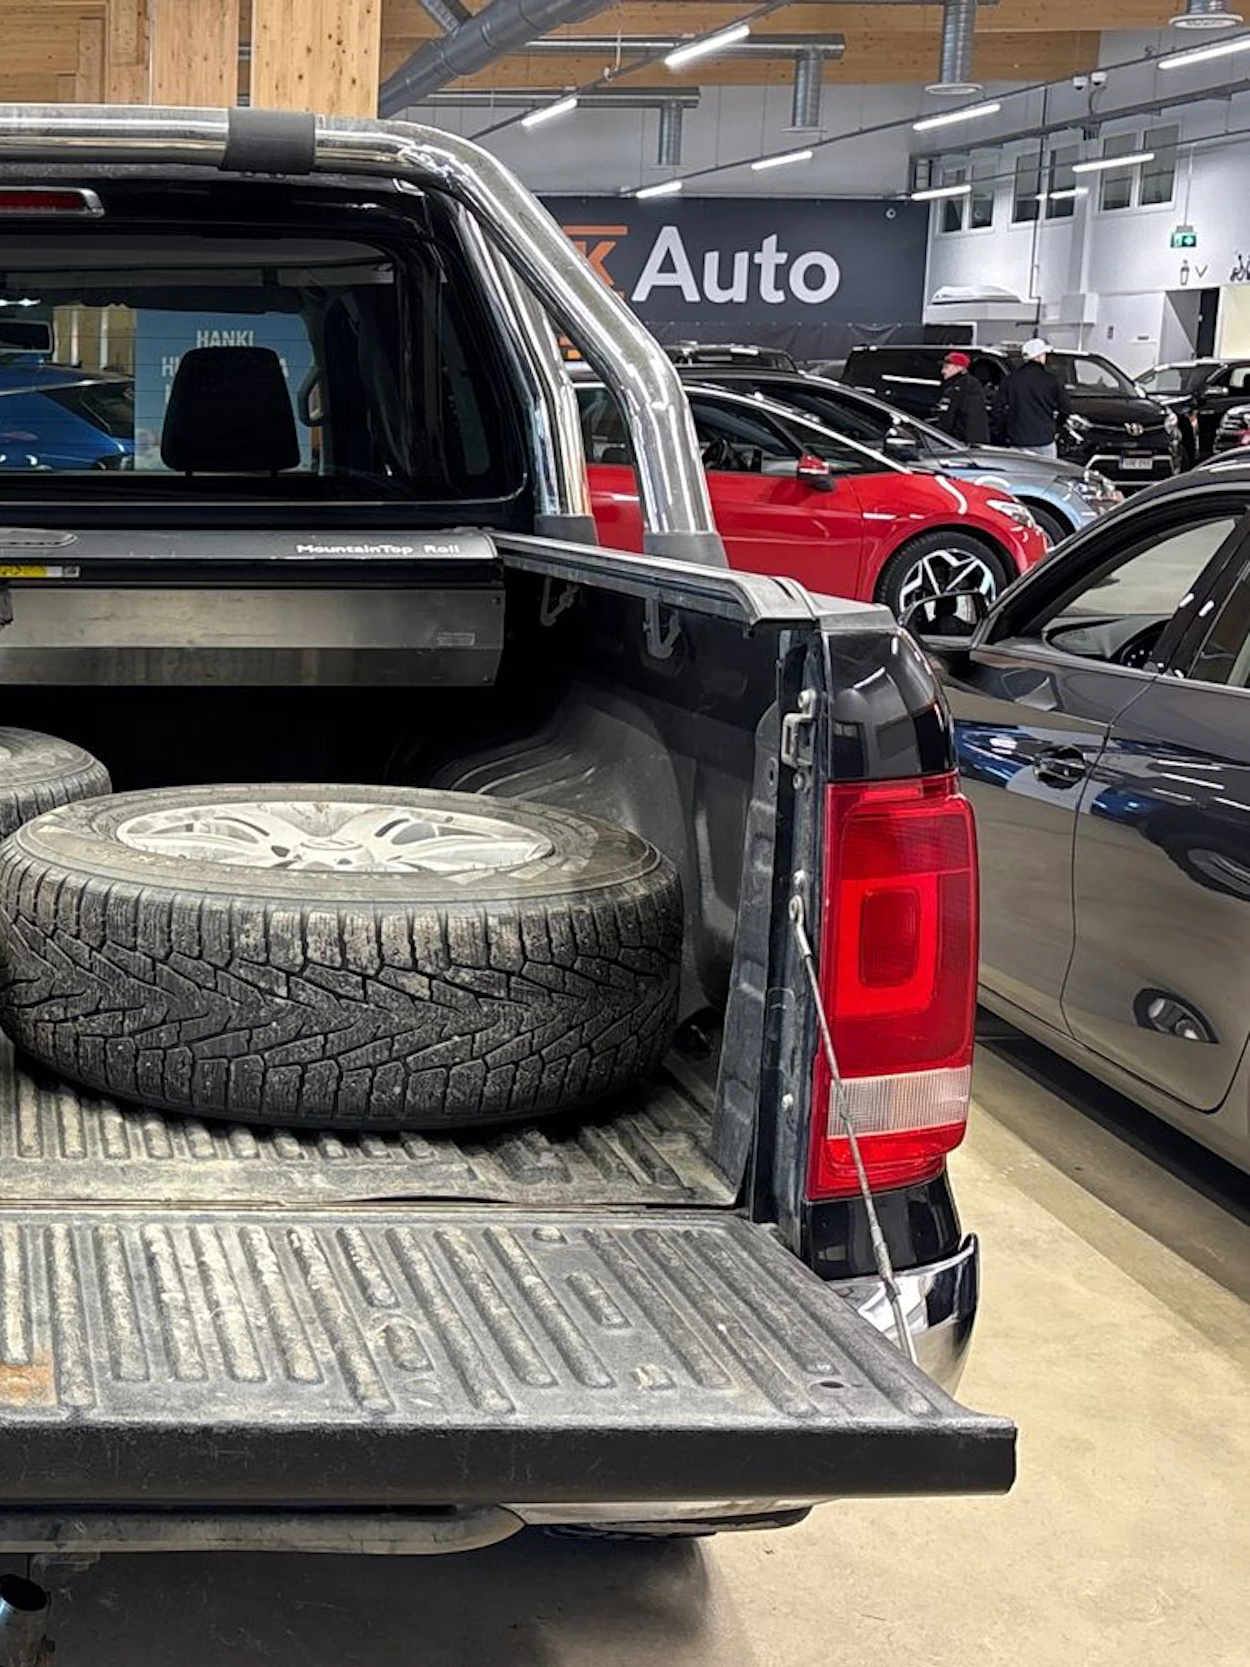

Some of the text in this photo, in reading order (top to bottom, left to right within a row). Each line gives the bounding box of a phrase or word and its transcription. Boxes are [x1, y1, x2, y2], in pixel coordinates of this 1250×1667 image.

[631, 225, 841, 303] Auto
[296, 544, 460, 555] MountainTop Roll
